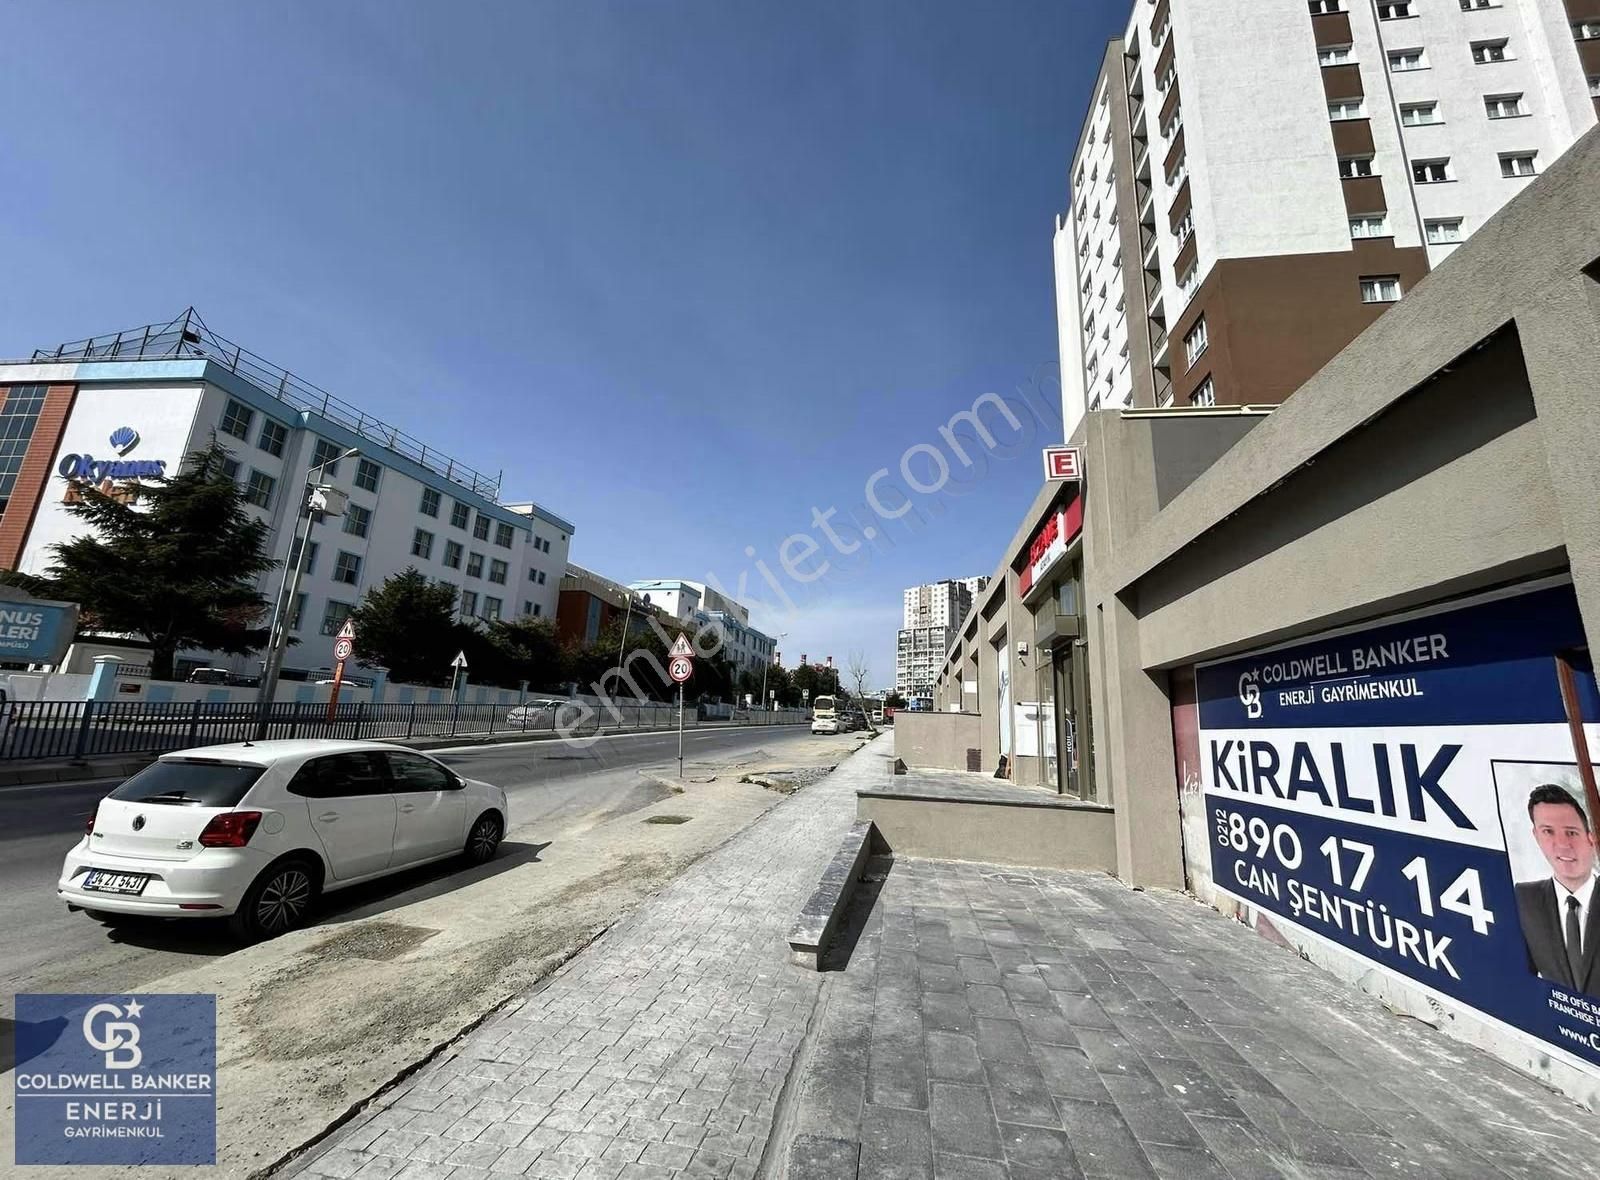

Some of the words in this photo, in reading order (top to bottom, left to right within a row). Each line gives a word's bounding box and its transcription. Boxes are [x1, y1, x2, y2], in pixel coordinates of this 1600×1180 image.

[59, 453, 167, 486] Okyanus
[1054, 455, 1074, 474] E
[338, 644, 348, 654] 20
[1263, 652, 1347, 684] COLDWELL
[1352, 633, 1449, 671] BANKER
[675, 664, 687, 674] 20
[1279, 686, 1315, 706] ENERJİ
[1321, 678, 1424, 703] GAYRİMENKUL
[91, 872, 103, 885] 34
[1216, 809, 1229, 847] 0212
[1229, 812, 1302, 870] 890
[1319, 836, 1375, 893] 17
[1401, 856, 1495, 936] 14
[1234, 859, 1280, 901] CAN
[1287, 879, 1461, 981] ŞENTÜRK
[1551, 989, 1570, 1003] HER
